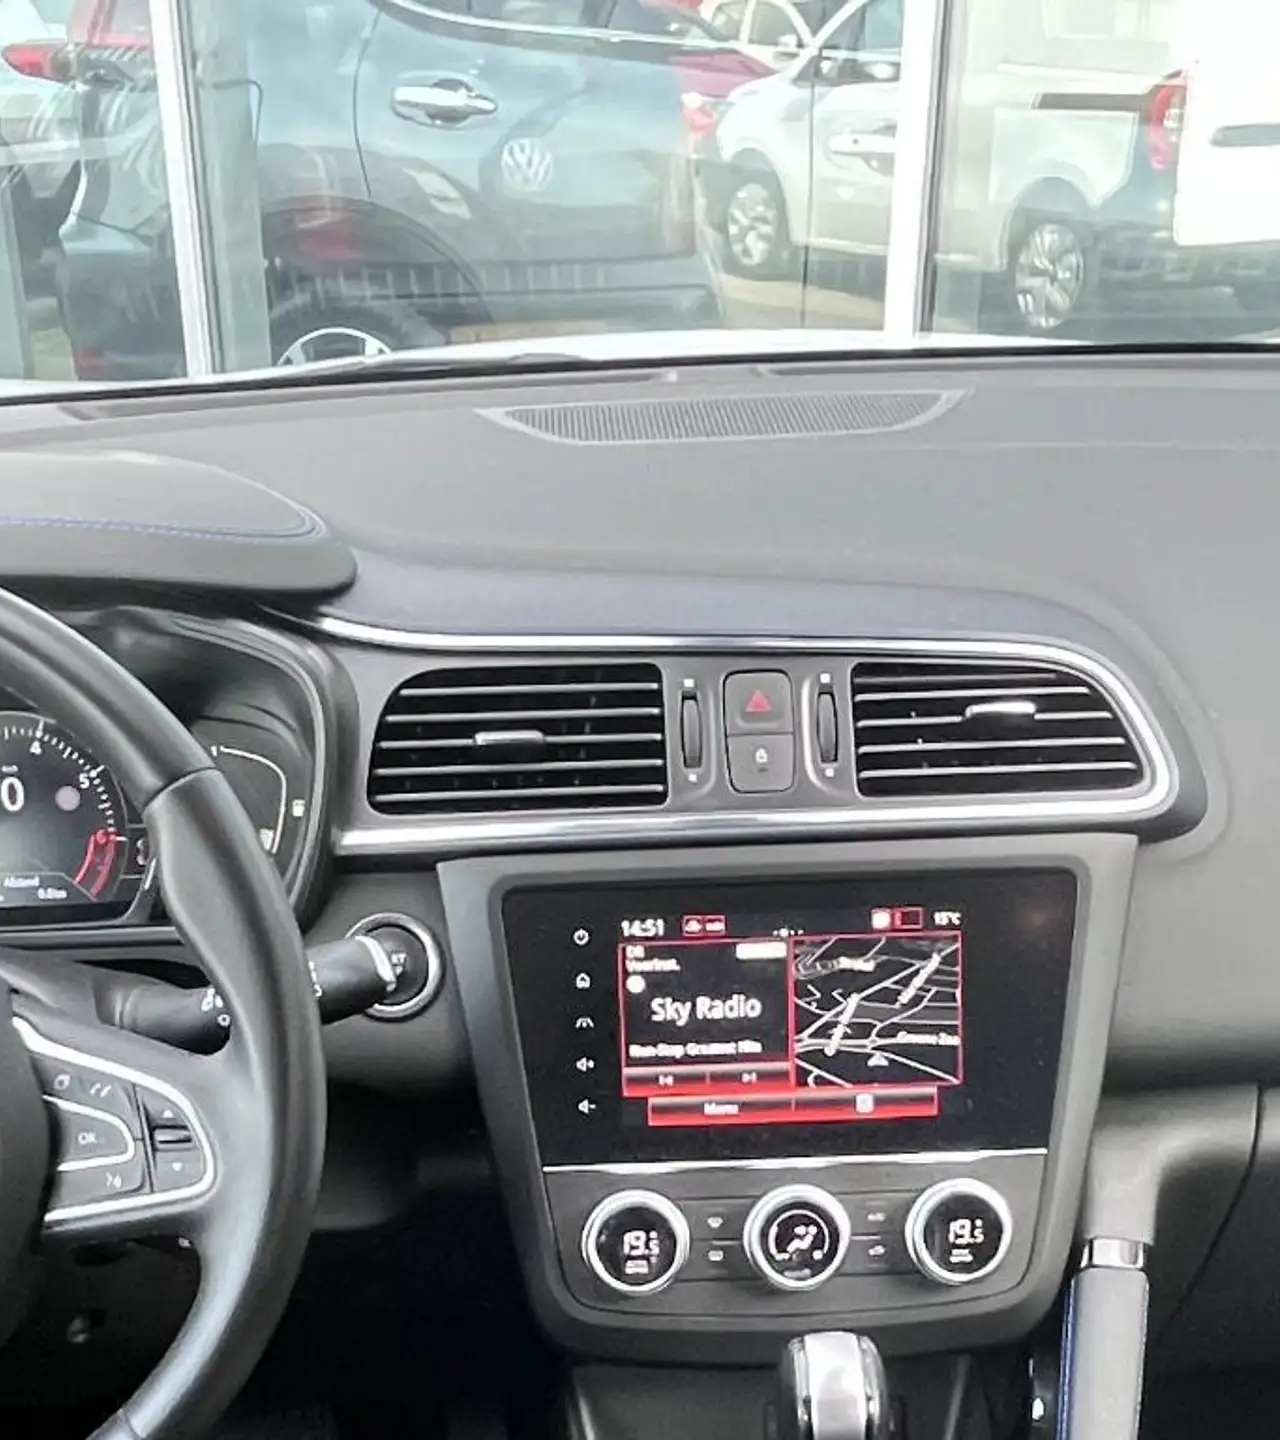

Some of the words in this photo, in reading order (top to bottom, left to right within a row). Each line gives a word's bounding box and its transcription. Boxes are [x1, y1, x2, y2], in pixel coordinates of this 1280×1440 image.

[28, 739, 43, 755] 4
[78, 771, 90, 789] 5
[0, 775, 26, 812] 0
[620, 918, 666, 938] 14:51
[650, 997, 692, 1027] Sky
[695, 993, 763, 1021] Radio
[77, 1131, 99, 1145] OK
